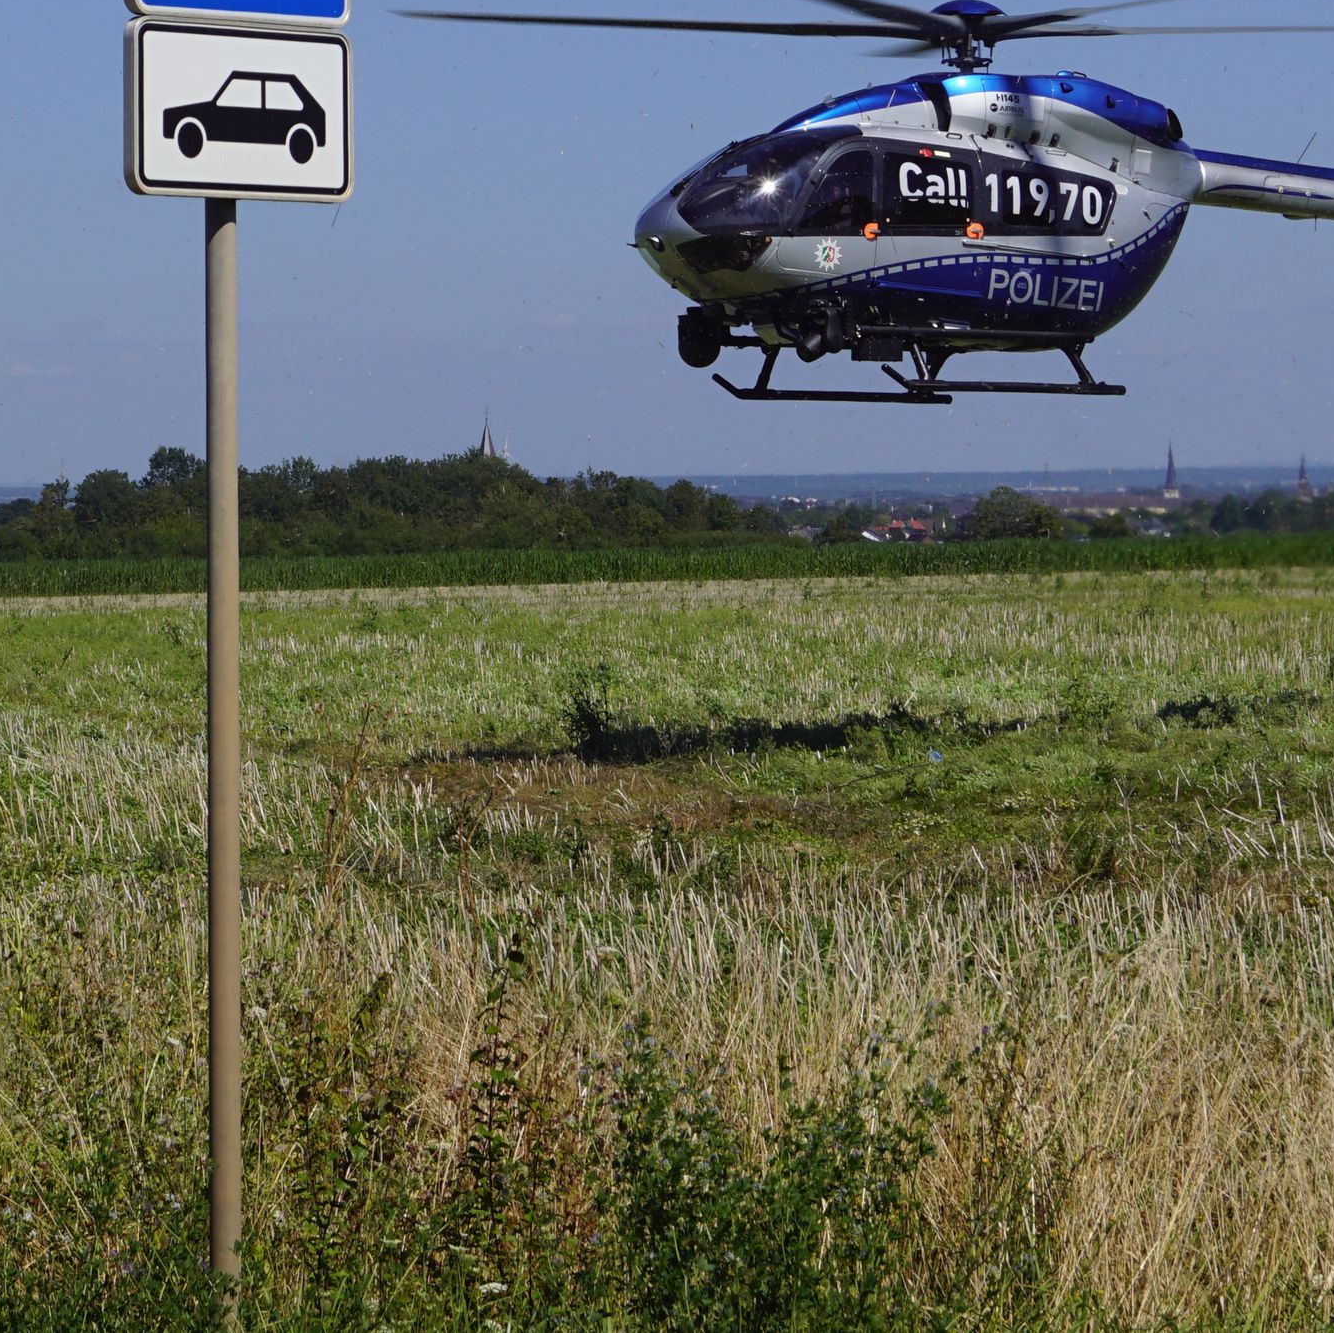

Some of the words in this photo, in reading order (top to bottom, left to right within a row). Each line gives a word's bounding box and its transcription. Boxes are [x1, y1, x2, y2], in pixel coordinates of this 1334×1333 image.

[996, 93, 1020, 104] H145
[999, 105, 1025, 114] AIRBUS
[898, 161, 969, 208] Call
[987, 267, 1105, 312] POLIZEI
